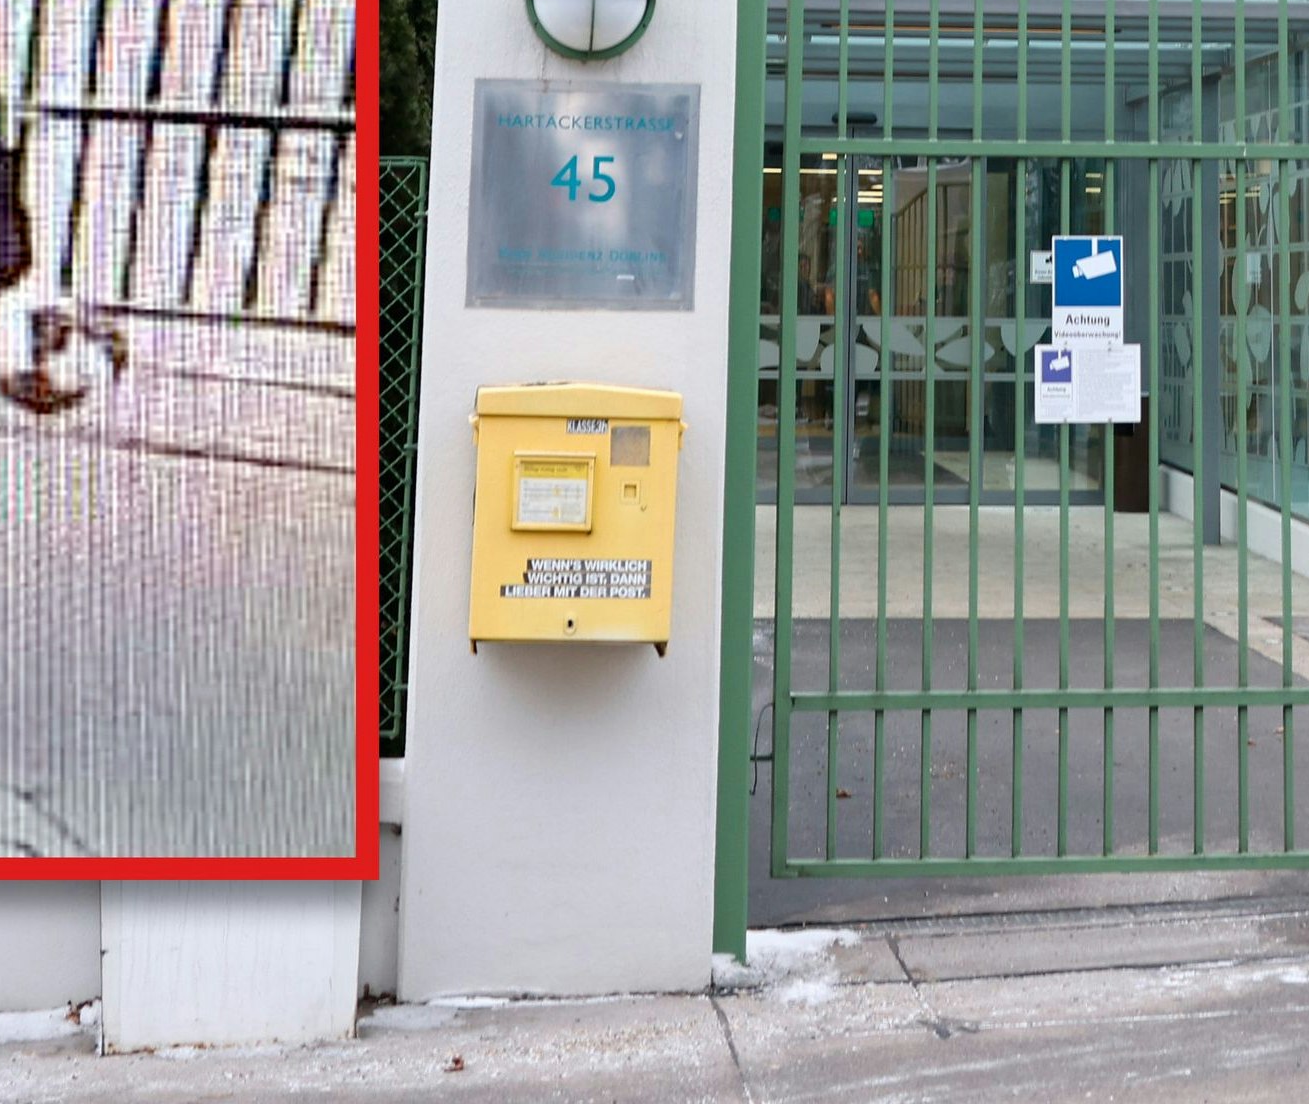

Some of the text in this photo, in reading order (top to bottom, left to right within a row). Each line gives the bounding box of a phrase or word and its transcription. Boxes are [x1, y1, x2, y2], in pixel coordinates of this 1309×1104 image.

[550, 155, 616, 203] 45
[1065, 314, 1110, 327] Achtung
[531, 560, 647, 571] WENN'S WIRKLICH
[528, 572, 583, 584] WICHTIG
[610, 573, 646, 584] DANN
[505, 585, 646, 598] LIEBER MIT DER POST.
